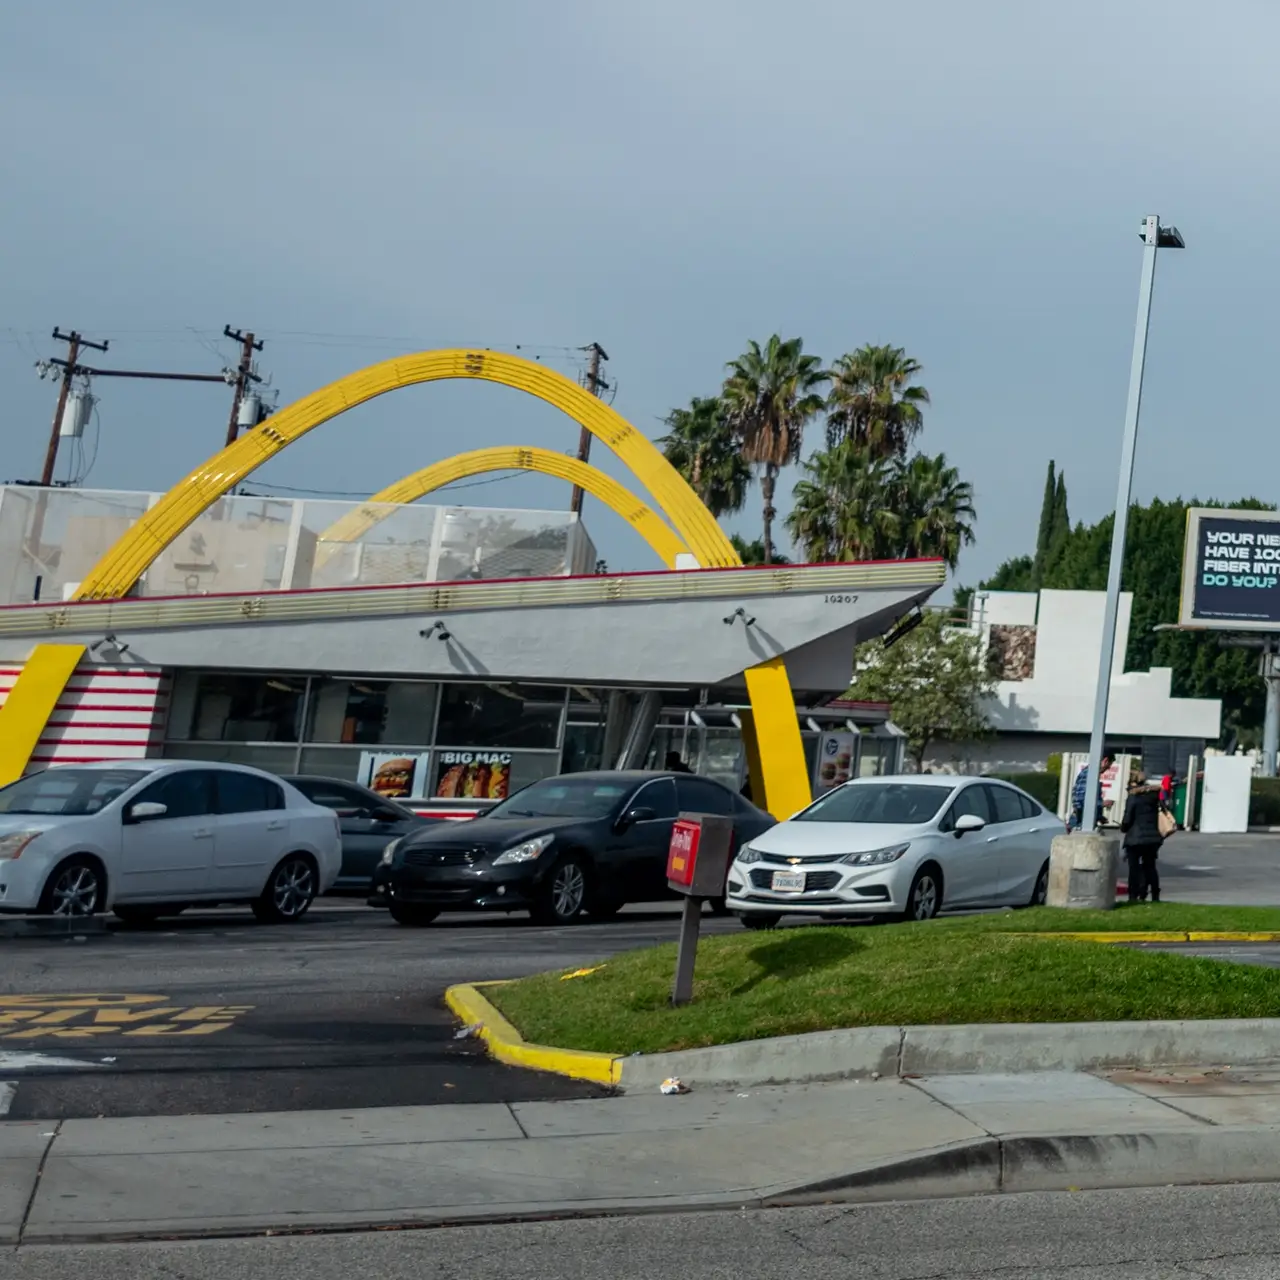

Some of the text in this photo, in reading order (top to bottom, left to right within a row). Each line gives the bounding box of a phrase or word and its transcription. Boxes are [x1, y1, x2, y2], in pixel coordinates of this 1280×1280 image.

[1206, 531, 1254, 546] YOUR
[1204, 546, 1249, 559] HAVE
[1203, 560, 1251, 573] FIBER
[1202, 573, 1278, 588] DO YOU?
[824, 595, 859, 605] 10207
[444, 751, 473, 764] BIG
[475, 752, 513, 765] MAC
